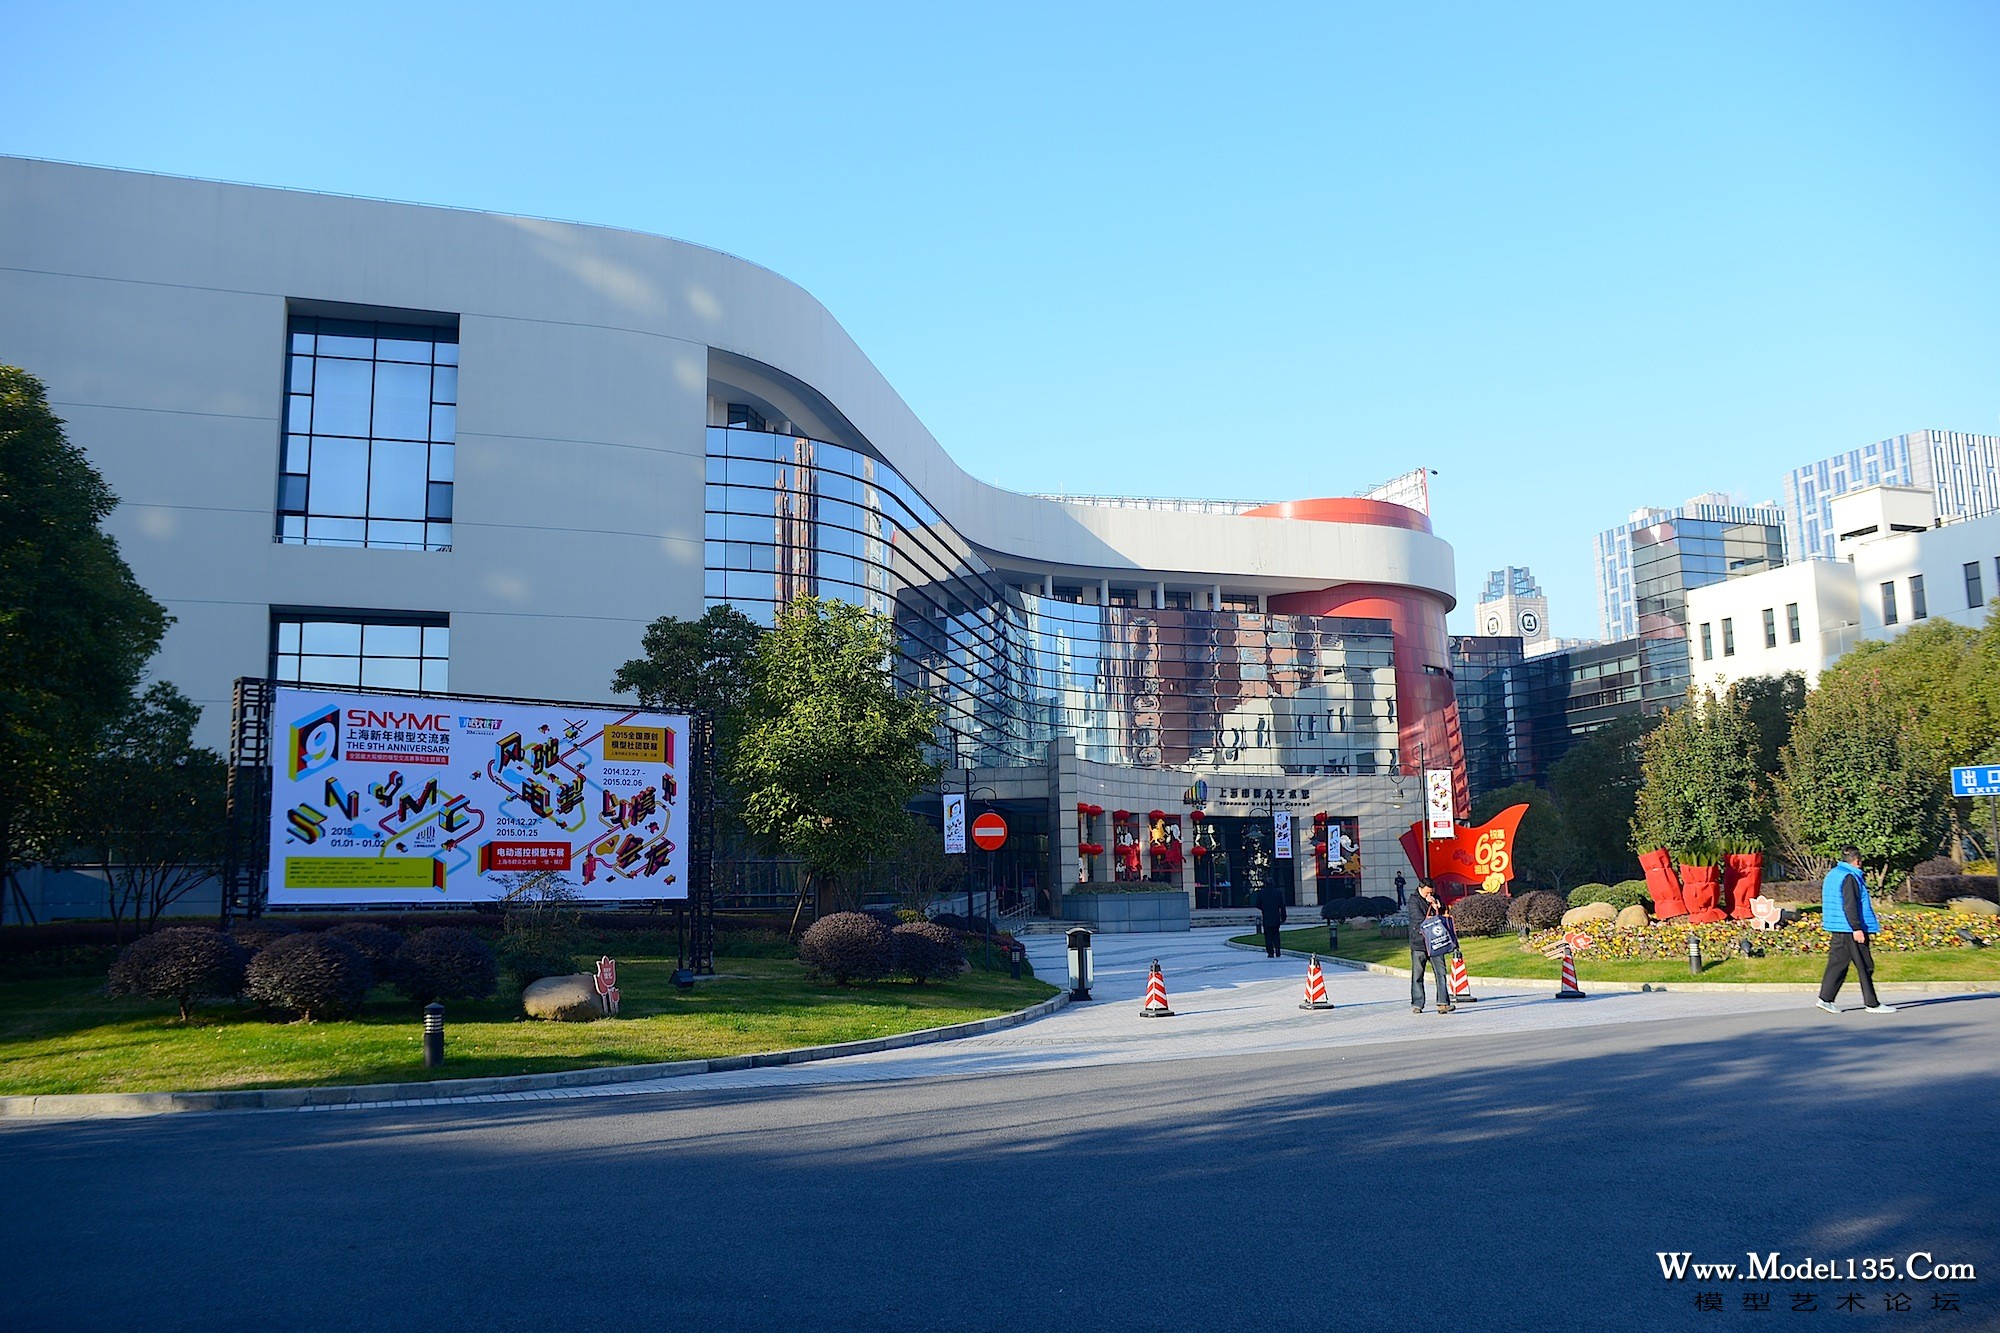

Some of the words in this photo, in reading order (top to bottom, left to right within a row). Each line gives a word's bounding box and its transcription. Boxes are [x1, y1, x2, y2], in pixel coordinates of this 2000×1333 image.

[347, 709, 450, 732] SNYMC
[346, 729, 450, 745] 上海新年模型交流赛
[611, 731, 659, 741] 2015全国原创
[347, 741, 364, 750] THE
[367, 742, 385, 751] 9TH
[387, 743, 450, 754] ANNIVERSARY
[611, 741, 658, 751] 模型社团联展
[603, 767, 641, 776] 2014.12.27
[603, 778, 643, 787] 2015.02.06
[1961, 769, 2000, 787] 出口
[1967, 786, 2000, 794] EXIT
[496, 817, 537, 826] 2014.12.27
[496, 828, 538, 837] 2015.01.25
[331, 839, 354, 848] 01.01
[362, 839, 386, 848] 01.02
[497, 847, 565, 857] 电动遥控模型车展
[1475, 833, 1509, 873] 65
